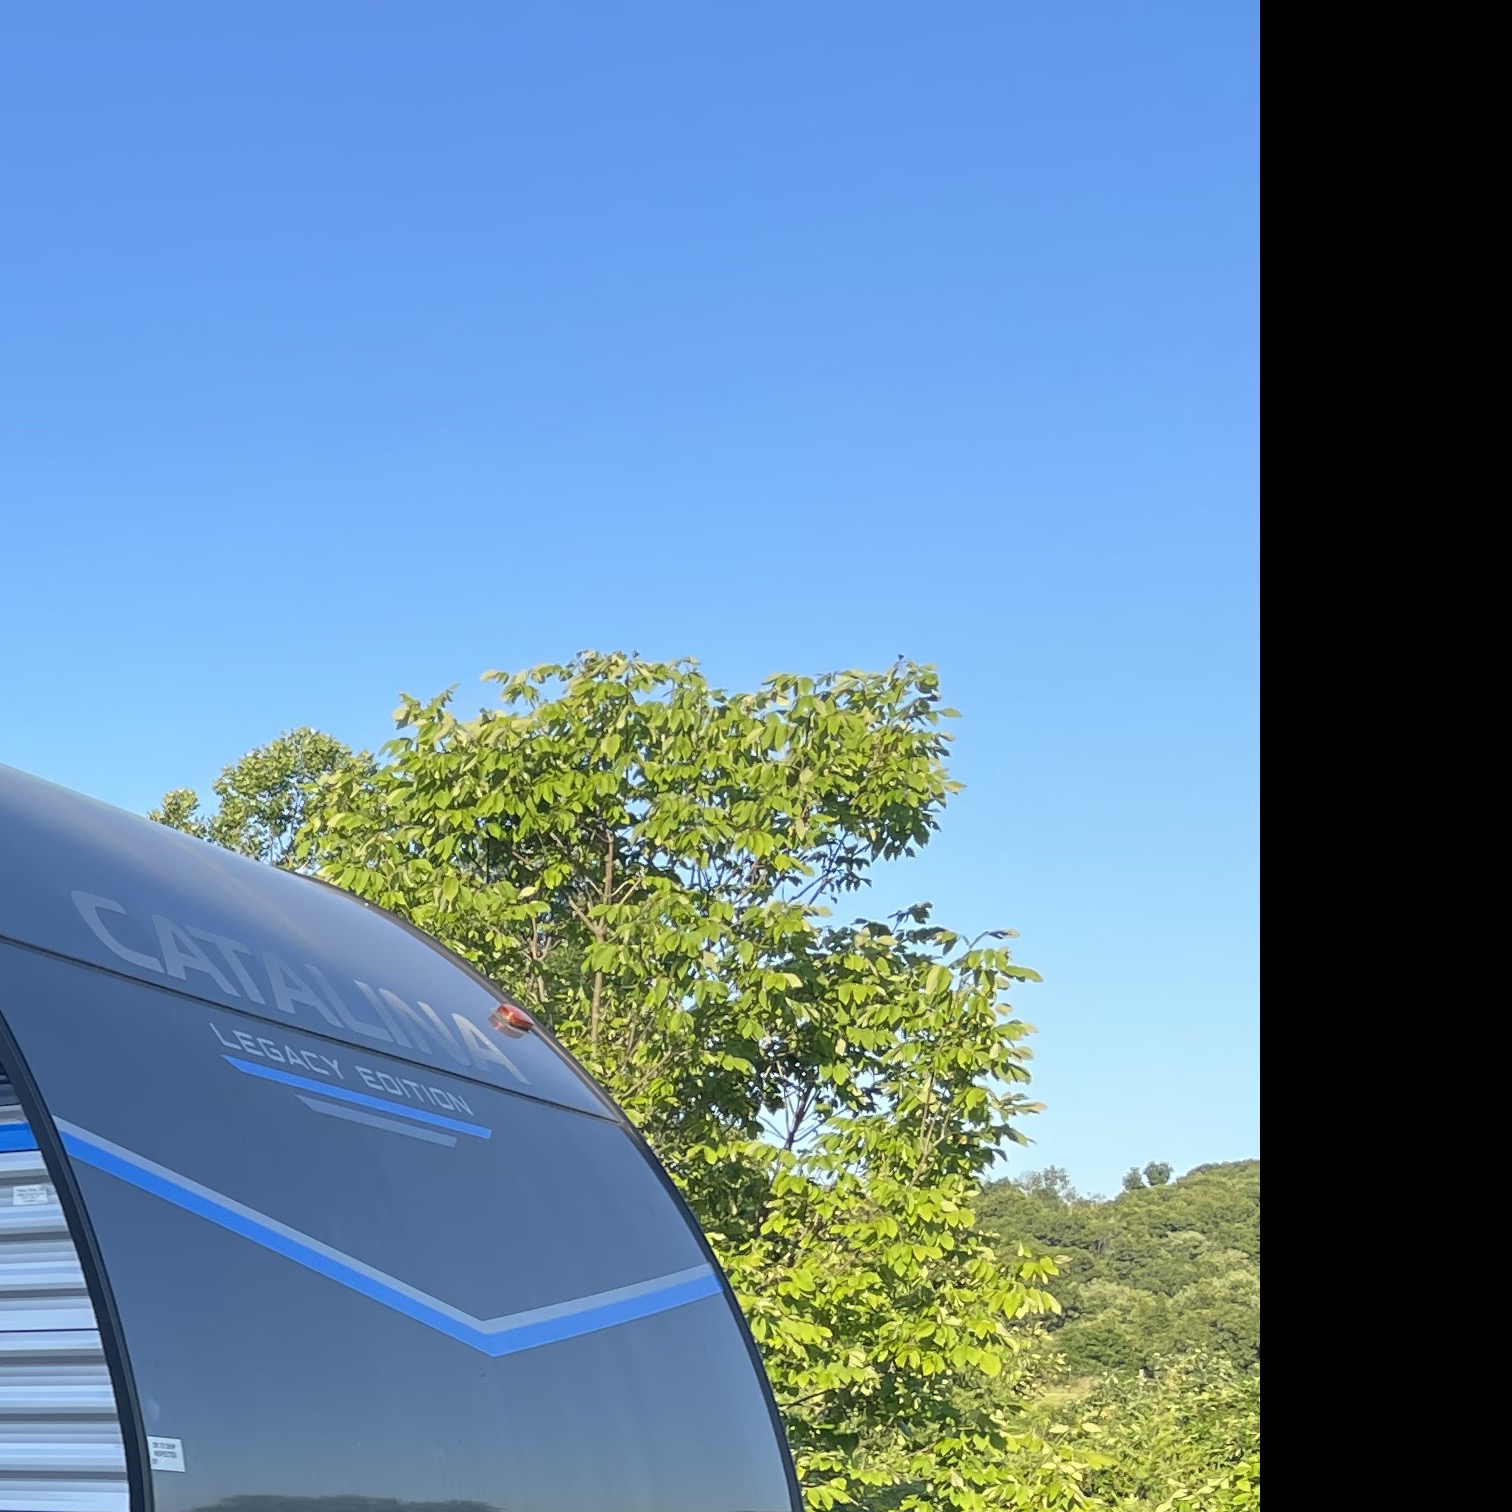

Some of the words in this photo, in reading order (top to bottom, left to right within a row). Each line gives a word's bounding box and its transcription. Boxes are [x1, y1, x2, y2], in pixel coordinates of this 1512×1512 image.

[70, 889, 529, 1085] CATALINA
[208, 1022, 345, 1079] LEGACY
[355, 1064, 475, 1117] EDITION
